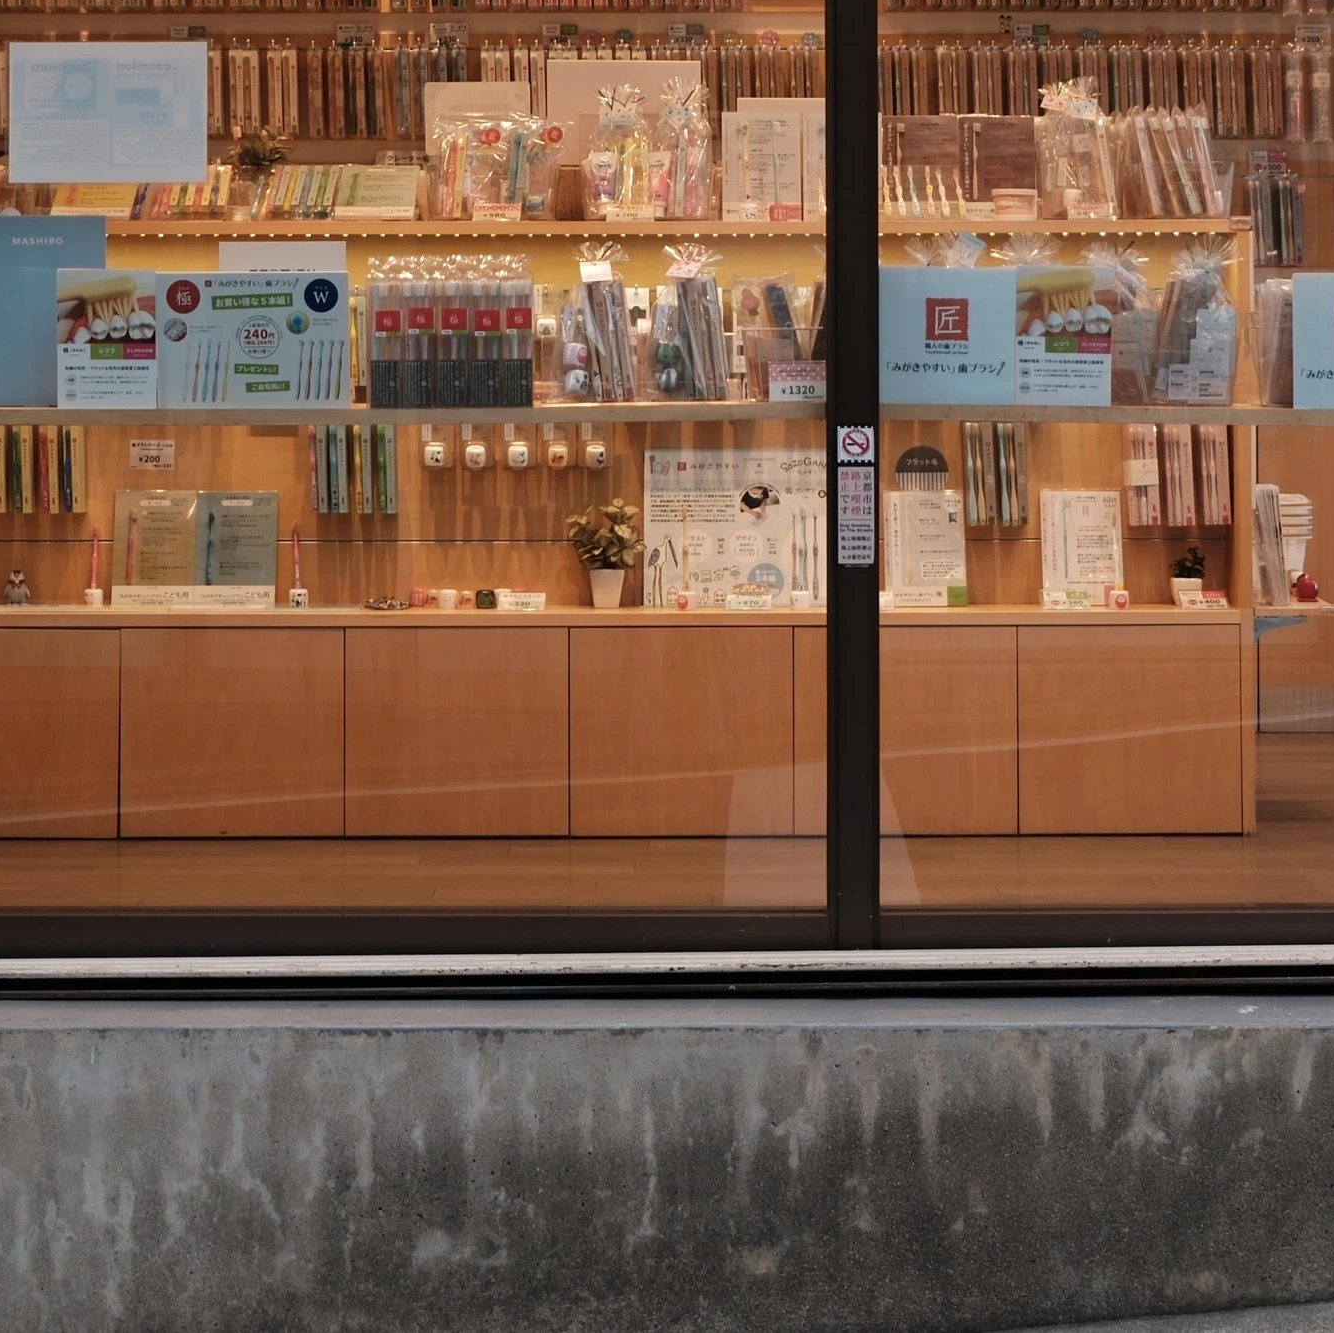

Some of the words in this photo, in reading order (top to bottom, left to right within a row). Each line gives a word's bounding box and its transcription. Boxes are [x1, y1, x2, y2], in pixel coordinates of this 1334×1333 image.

[11, 236, 64, 245] MASHIRO
[213, 279, 294, 288] 「みがきやすい」歯ブラシ
[175, 291, 192, 306] 極
[312, 291, 330, 304] W
[934, 306, 962, 335] 匠
[243, 328, 275, 340] 240円
[886, 361, 998, 374] 「みがきやすい」歯ブラシ
[781, 385, 815, 395] ¥1320
[139, 455, 161, 463] ¥200
[905, 458, 938, 466] フラット毛
[690, 462, 739, 470] みがきやすい
[840, 470, 850, 515] 禁止です
[851, 470, 862, 516] 路上喫煙
[862, 470, 873, 515] 京都市は
